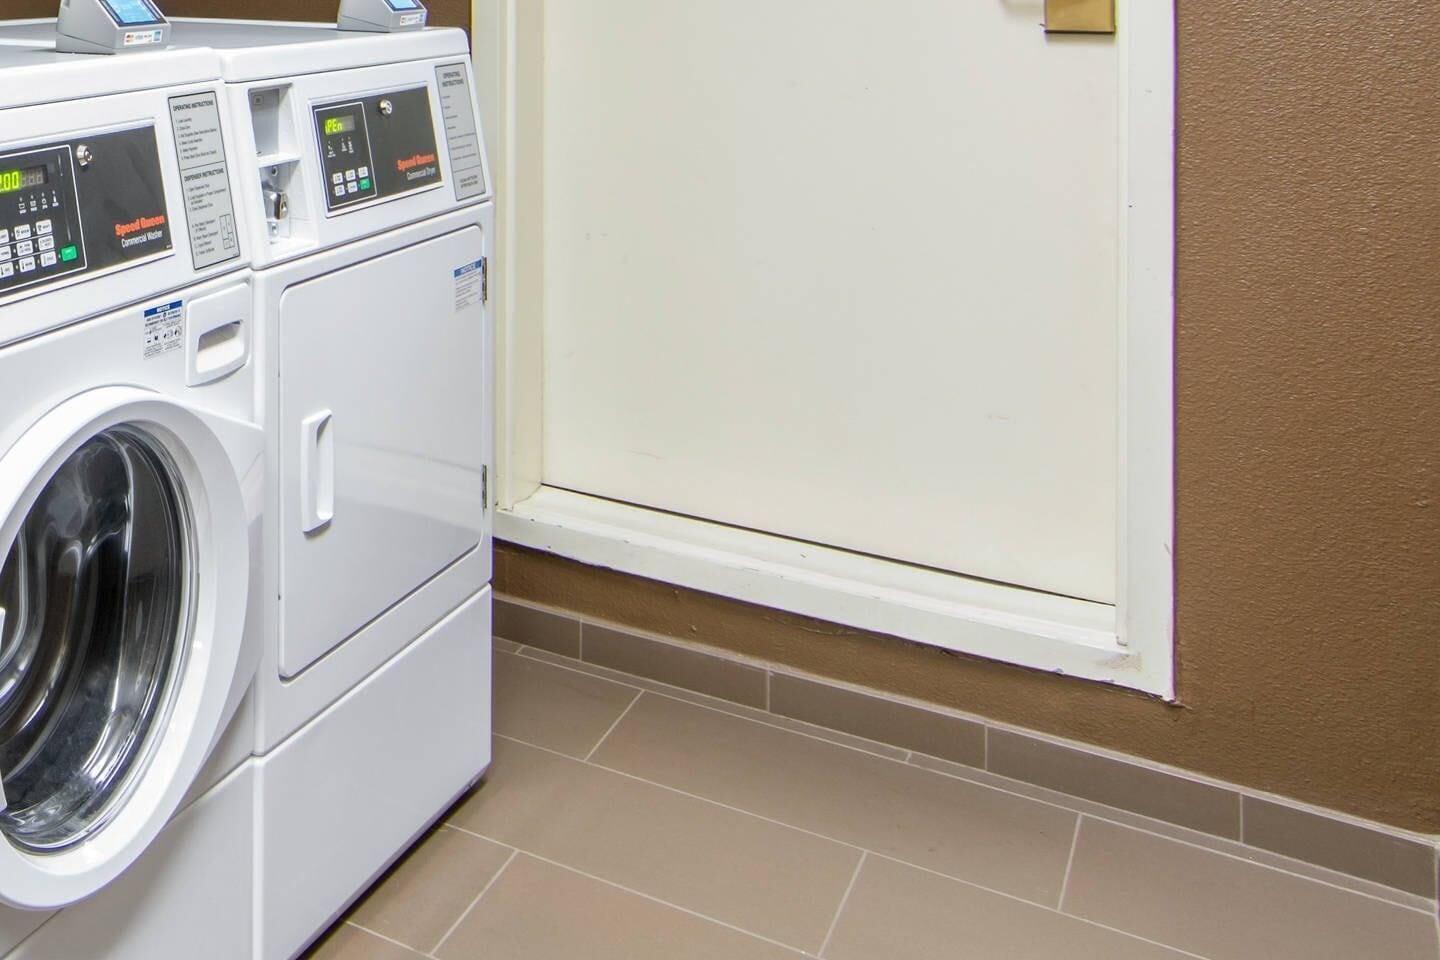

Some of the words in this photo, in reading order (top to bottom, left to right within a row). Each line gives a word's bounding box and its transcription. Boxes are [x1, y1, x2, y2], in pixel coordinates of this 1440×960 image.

[115, 218, 141, 237] Speed
[140, 215, 165, 229] Queen
[121, 233, 148, 248] Commercial
[147, 229, 163, 241] Washer
